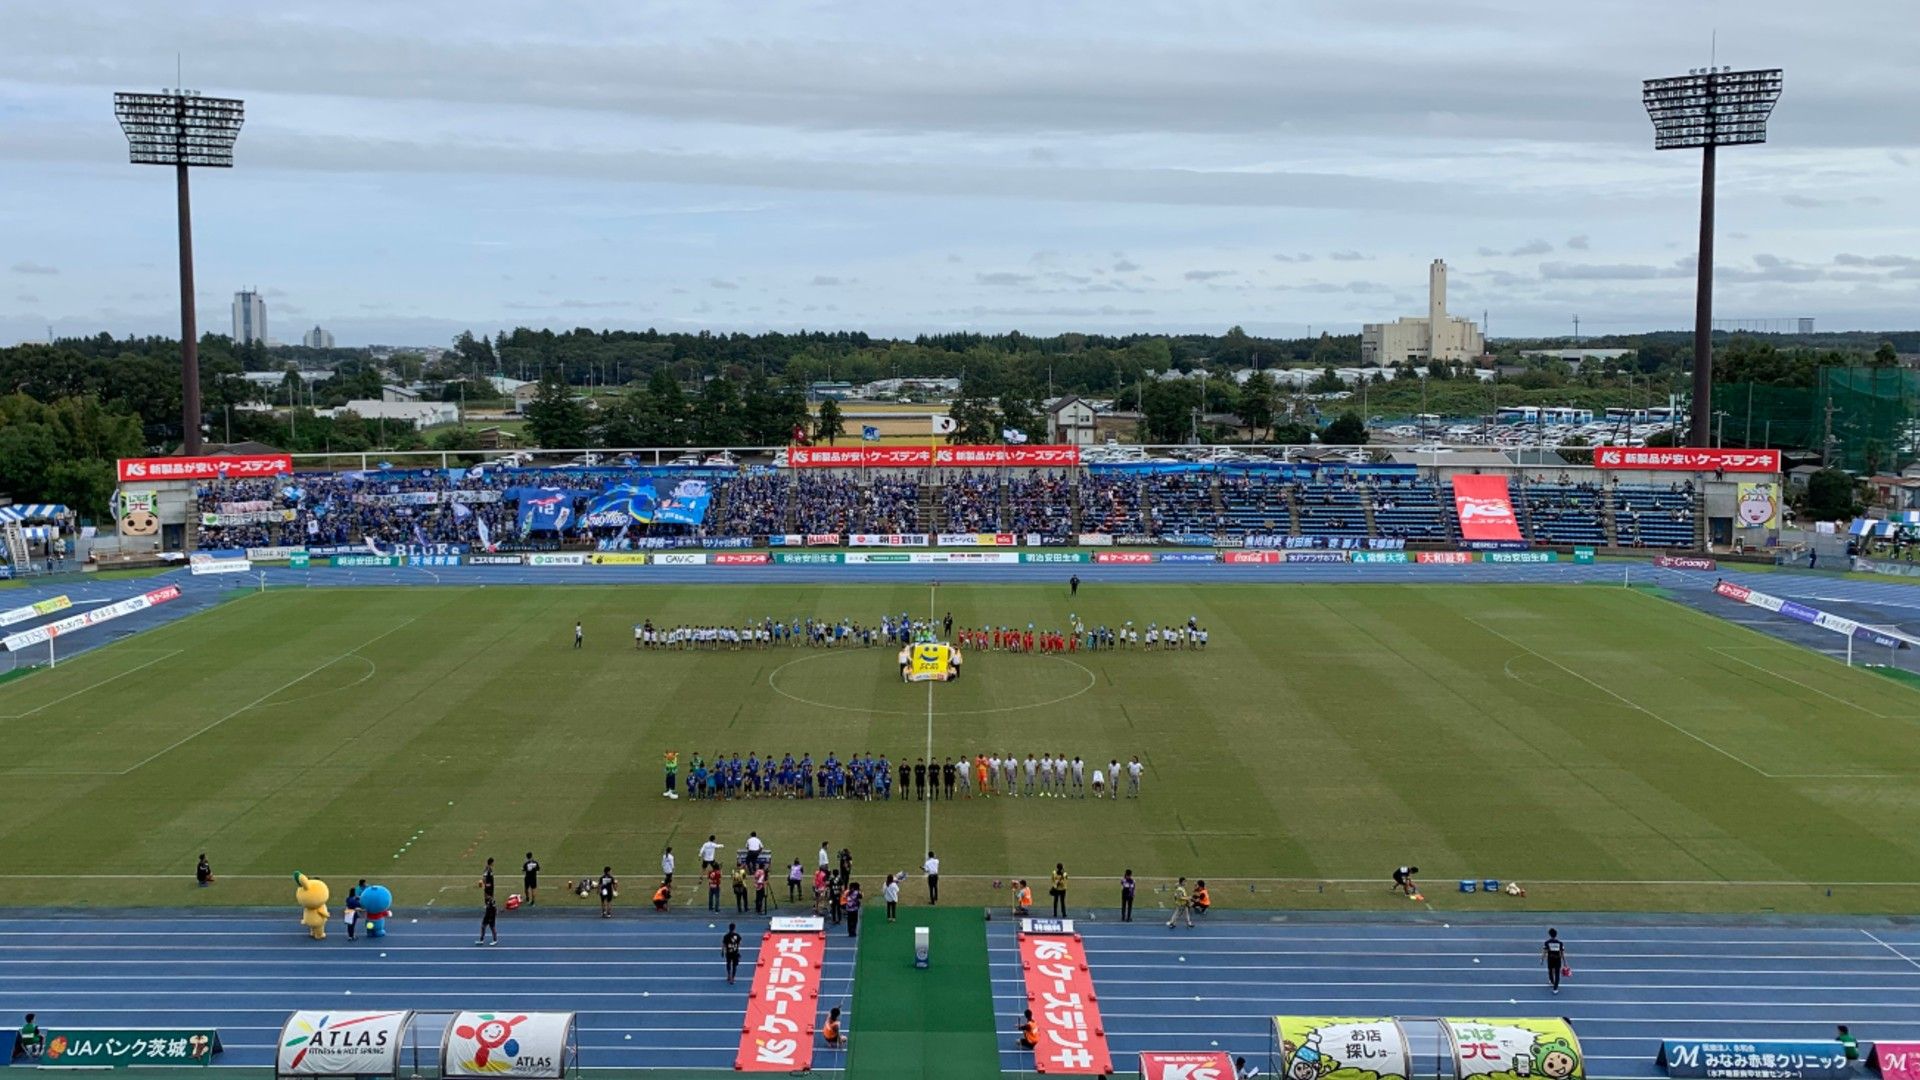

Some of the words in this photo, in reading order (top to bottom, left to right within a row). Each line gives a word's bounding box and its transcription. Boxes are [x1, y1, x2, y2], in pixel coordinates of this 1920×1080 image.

[149, 459, 286, 475] 新製品が安いケーズデンキ
[1625, 453, 1772, 466] 新製品が安いケーズデンキ
[308, 1030, 388, 1047] ATLAS
[1351, 1029, 1382, 1042] お店
[67, 1038, 187, 1057] JAバンク茨城
[1460, 1042, 1501, 1060] ナビ
[515, 1056, 551, 1067] ATLAS
[1705, 1054, 1847, 1069] みなみ赤塚クリニック
